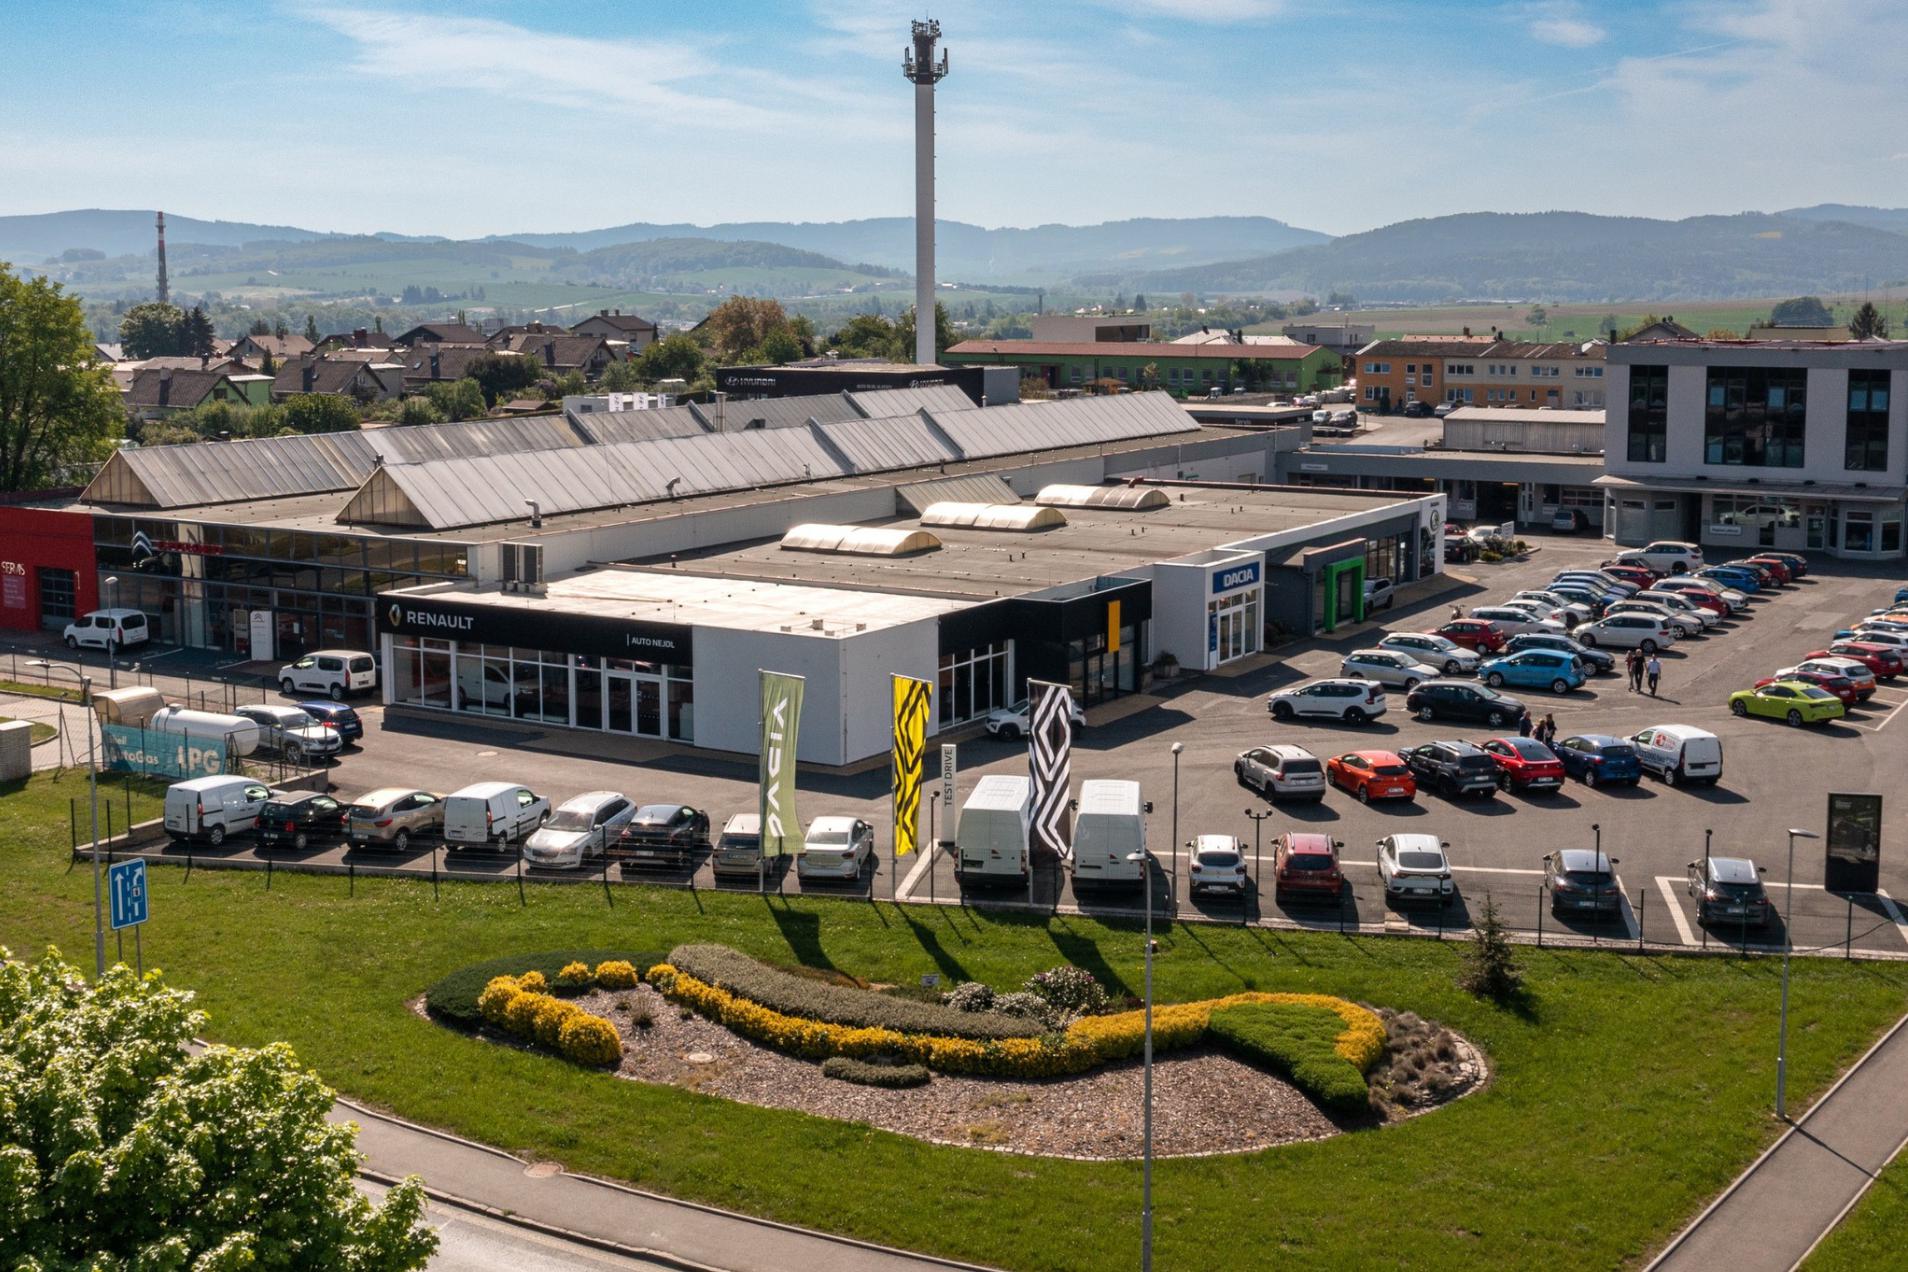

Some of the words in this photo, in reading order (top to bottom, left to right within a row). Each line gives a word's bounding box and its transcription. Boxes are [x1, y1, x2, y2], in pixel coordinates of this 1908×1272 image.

[1223, 570, 1254, 588] DACIA
[406, 610, 475, 631] RENAULT
[631, 636, 652, 646] AUTO
[652, 639, 676, 648] NEJDL
[177, 745, 222, 774] LPG
[943, 749, 953, 780] DRIVE
[943, 782, 953, 807] TEST
